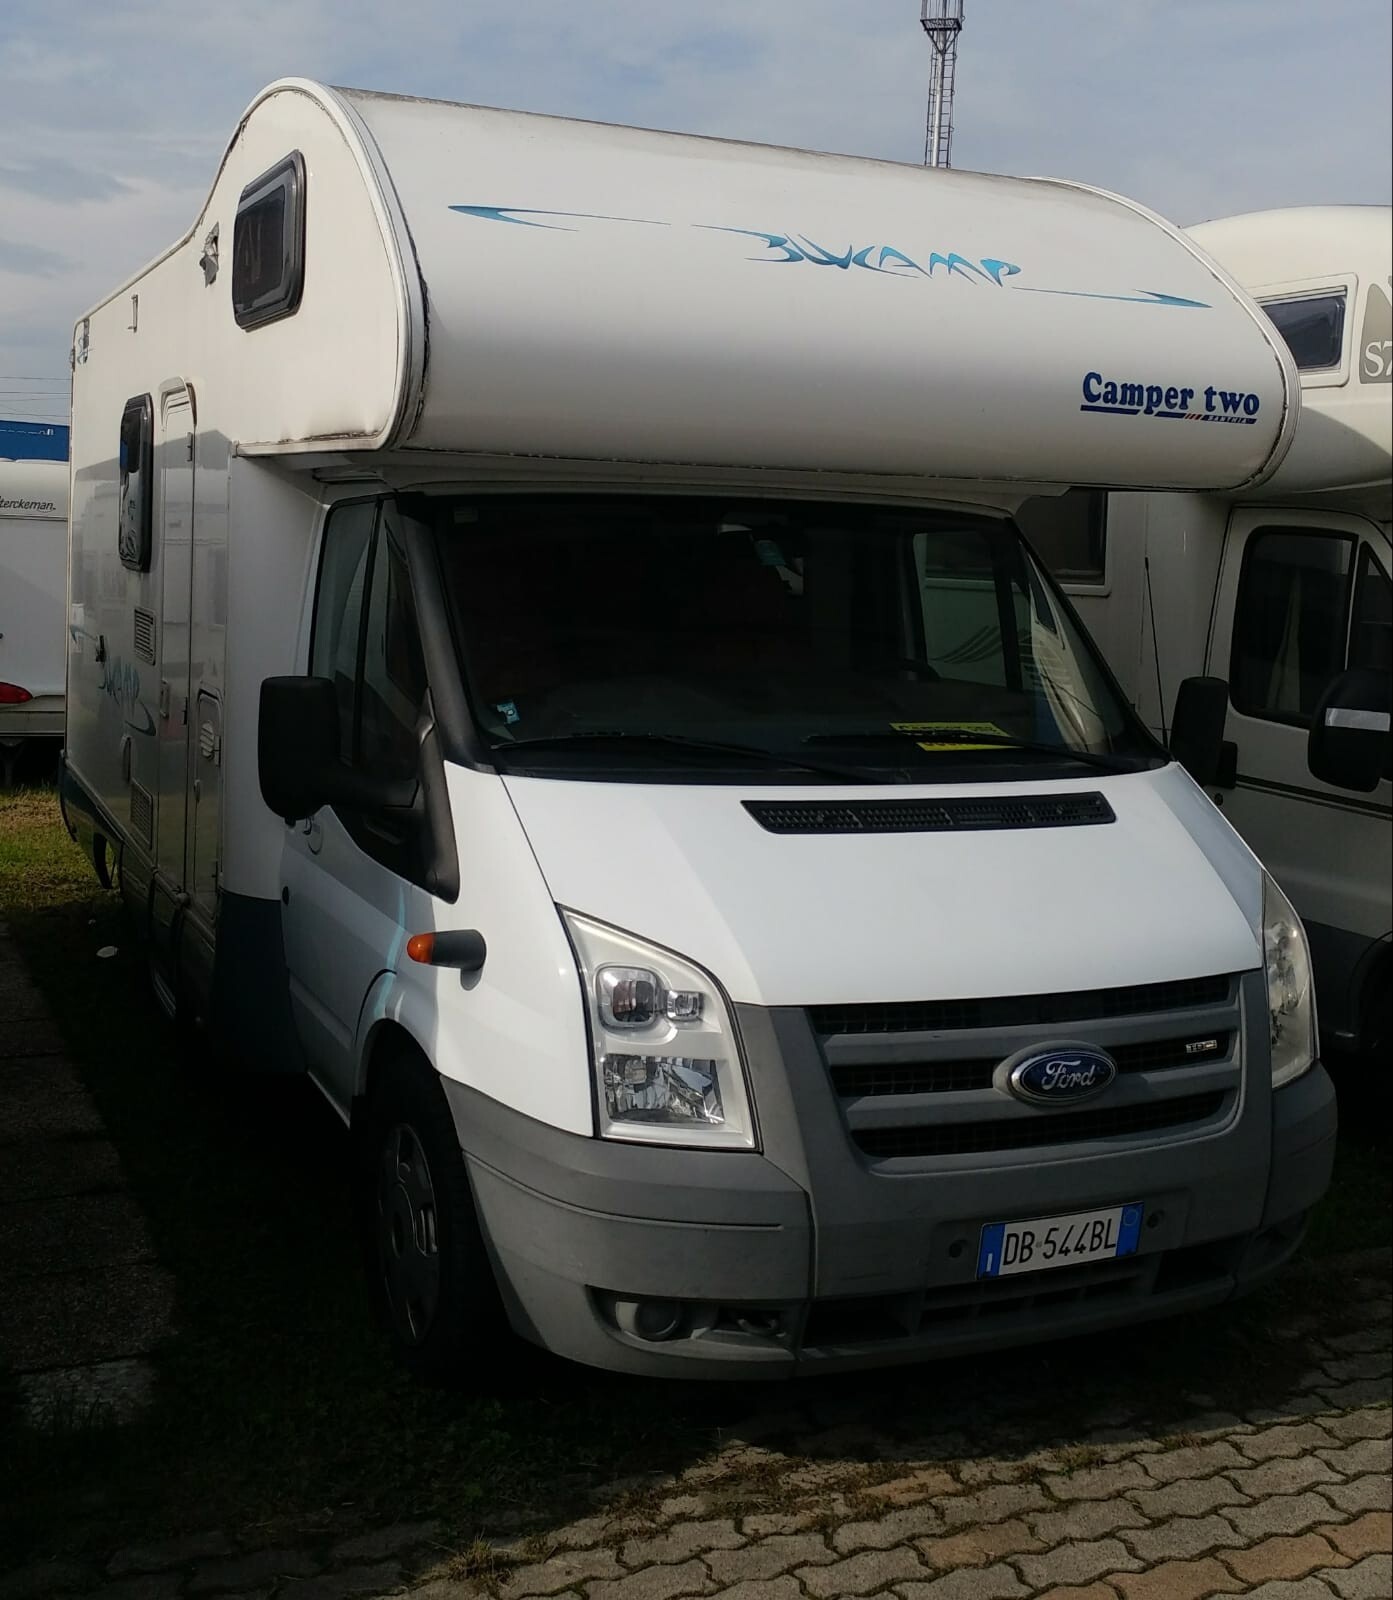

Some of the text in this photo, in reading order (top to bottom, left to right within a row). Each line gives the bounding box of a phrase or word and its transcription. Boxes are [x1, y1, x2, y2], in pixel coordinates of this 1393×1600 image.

[1082, 371, 1260, 416] Camper two
[1041, 1059, 1096, 1090] Ford
[1002, 1230, 1035, 1266] DB
[1042, 1218, 1116, 1260] 544BL
